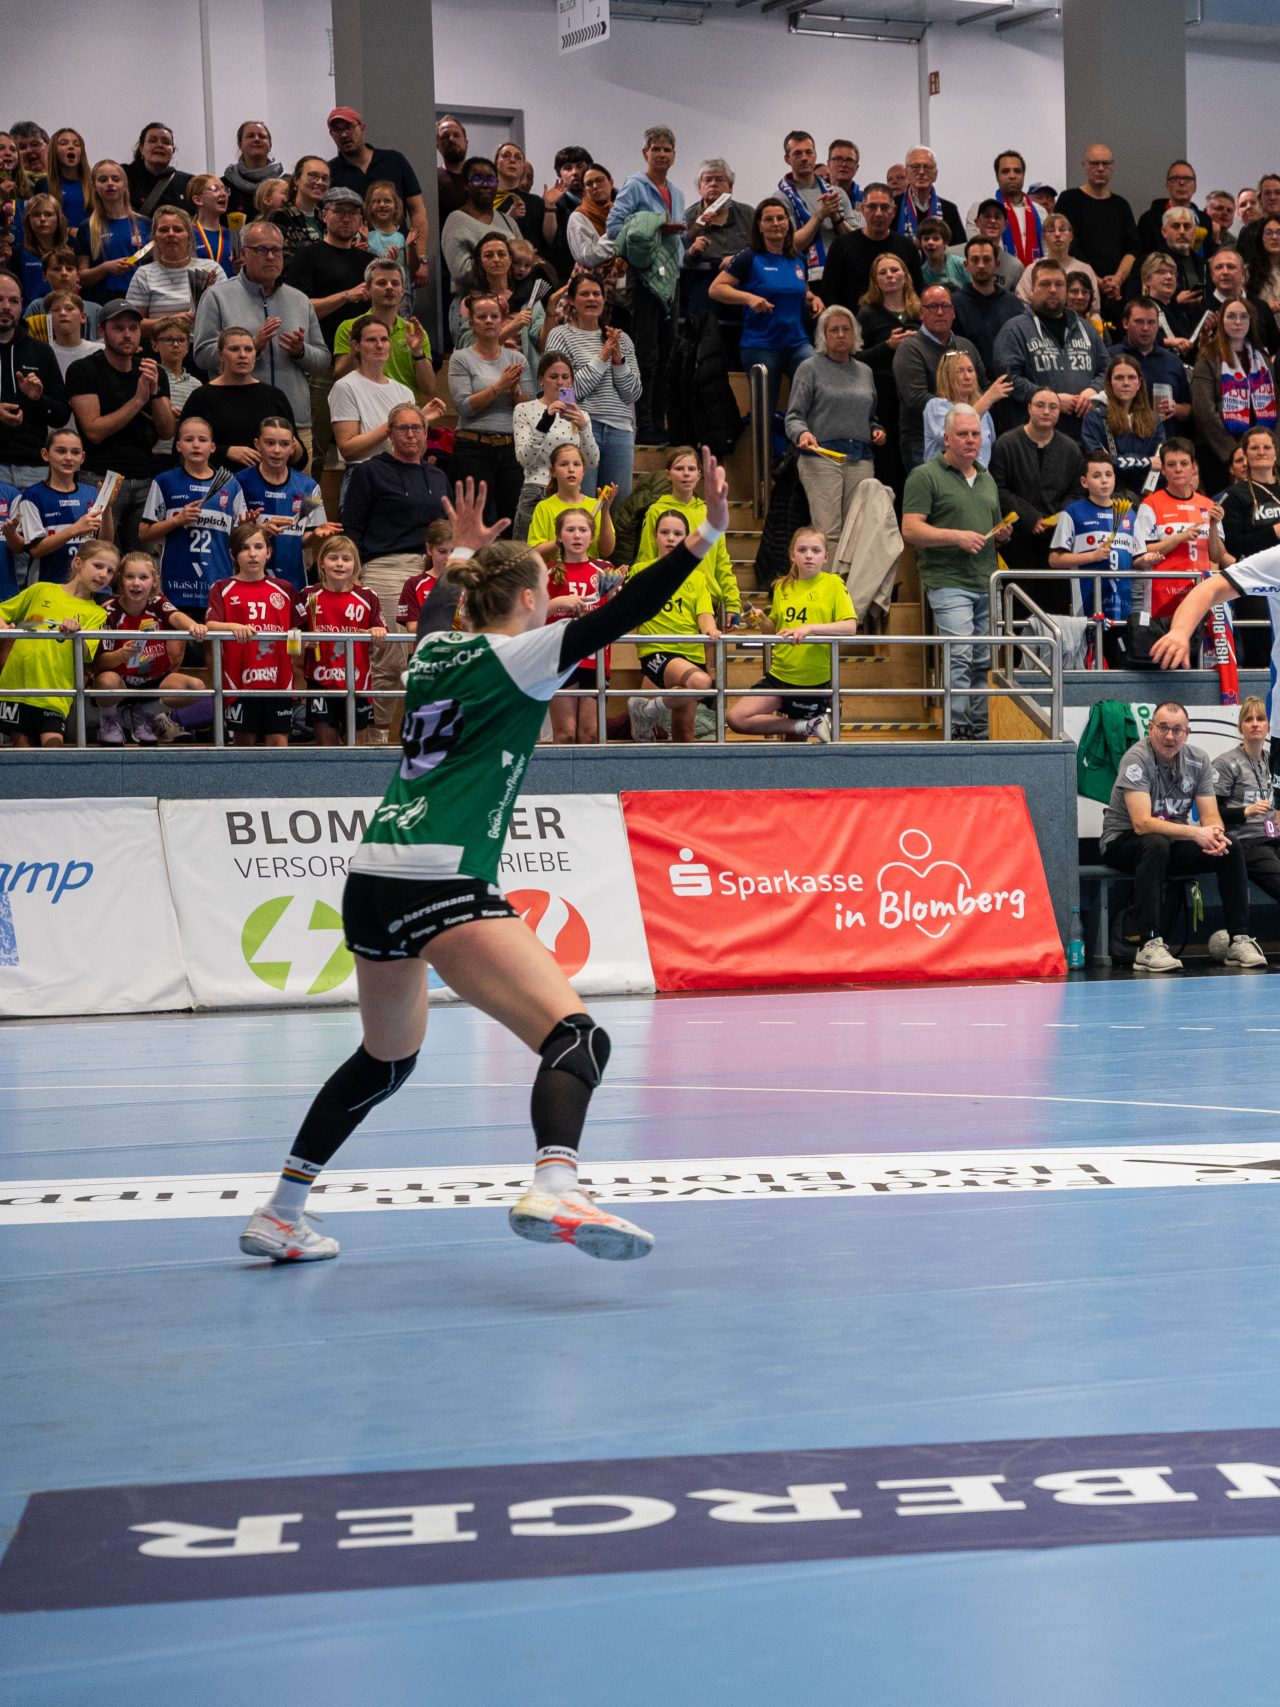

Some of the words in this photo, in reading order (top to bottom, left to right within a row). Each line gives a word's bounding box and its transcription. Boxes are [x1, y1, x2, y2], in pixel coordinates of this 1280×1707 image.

[190, 530, 212, 553] 22
[1109, 551, 1119, 571] 9
[1187, 542, 1197, 561] 5
[247, 601, 267, 620] 37
[344, 603, 364, 622] 40
[785, 607, 808, 624] 94
[242, 667, 278, 685] CORNY
[718, 869, 864, 901] Sparkasse
[404, 893, 475, 923] horstmann
[835, 902, 866, 930] in
[879, 884, 1026, 929] Blomberg
[884, 1163, 1100, 1179] HSG
